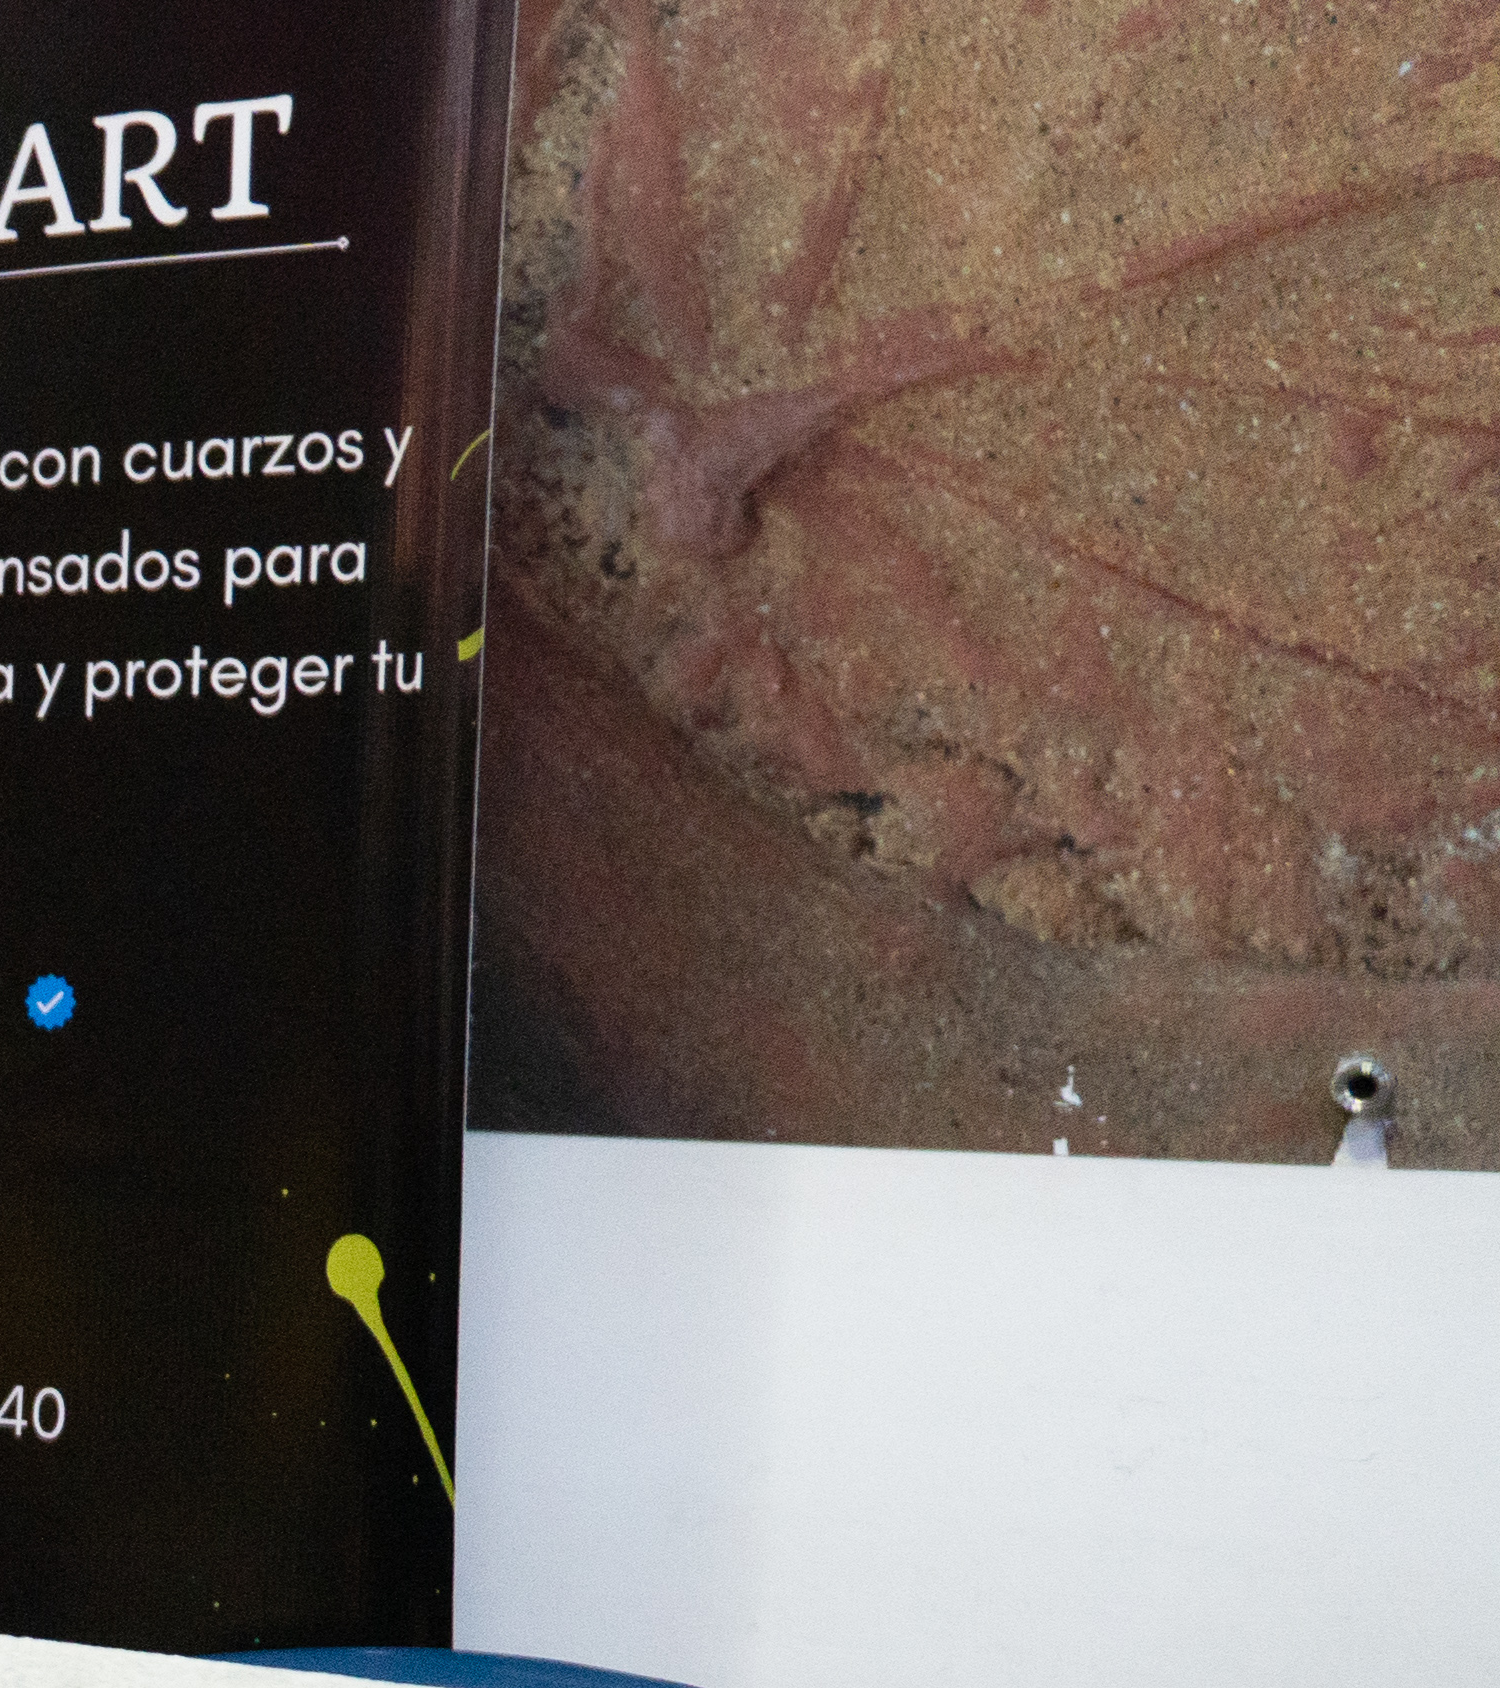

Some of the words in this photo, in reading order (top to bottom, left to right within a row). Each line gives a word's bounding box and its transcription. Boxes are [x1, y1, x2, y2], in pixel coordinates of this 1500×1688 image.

[122, 428, 365, 483] cuarzos
[383, 424, 414, 488] y
[222, 532, 368, 608] para
[35, 662, 66, 720] y
[84, 644, 355, 719] proteger
[371, 639, 424, 693] tu
